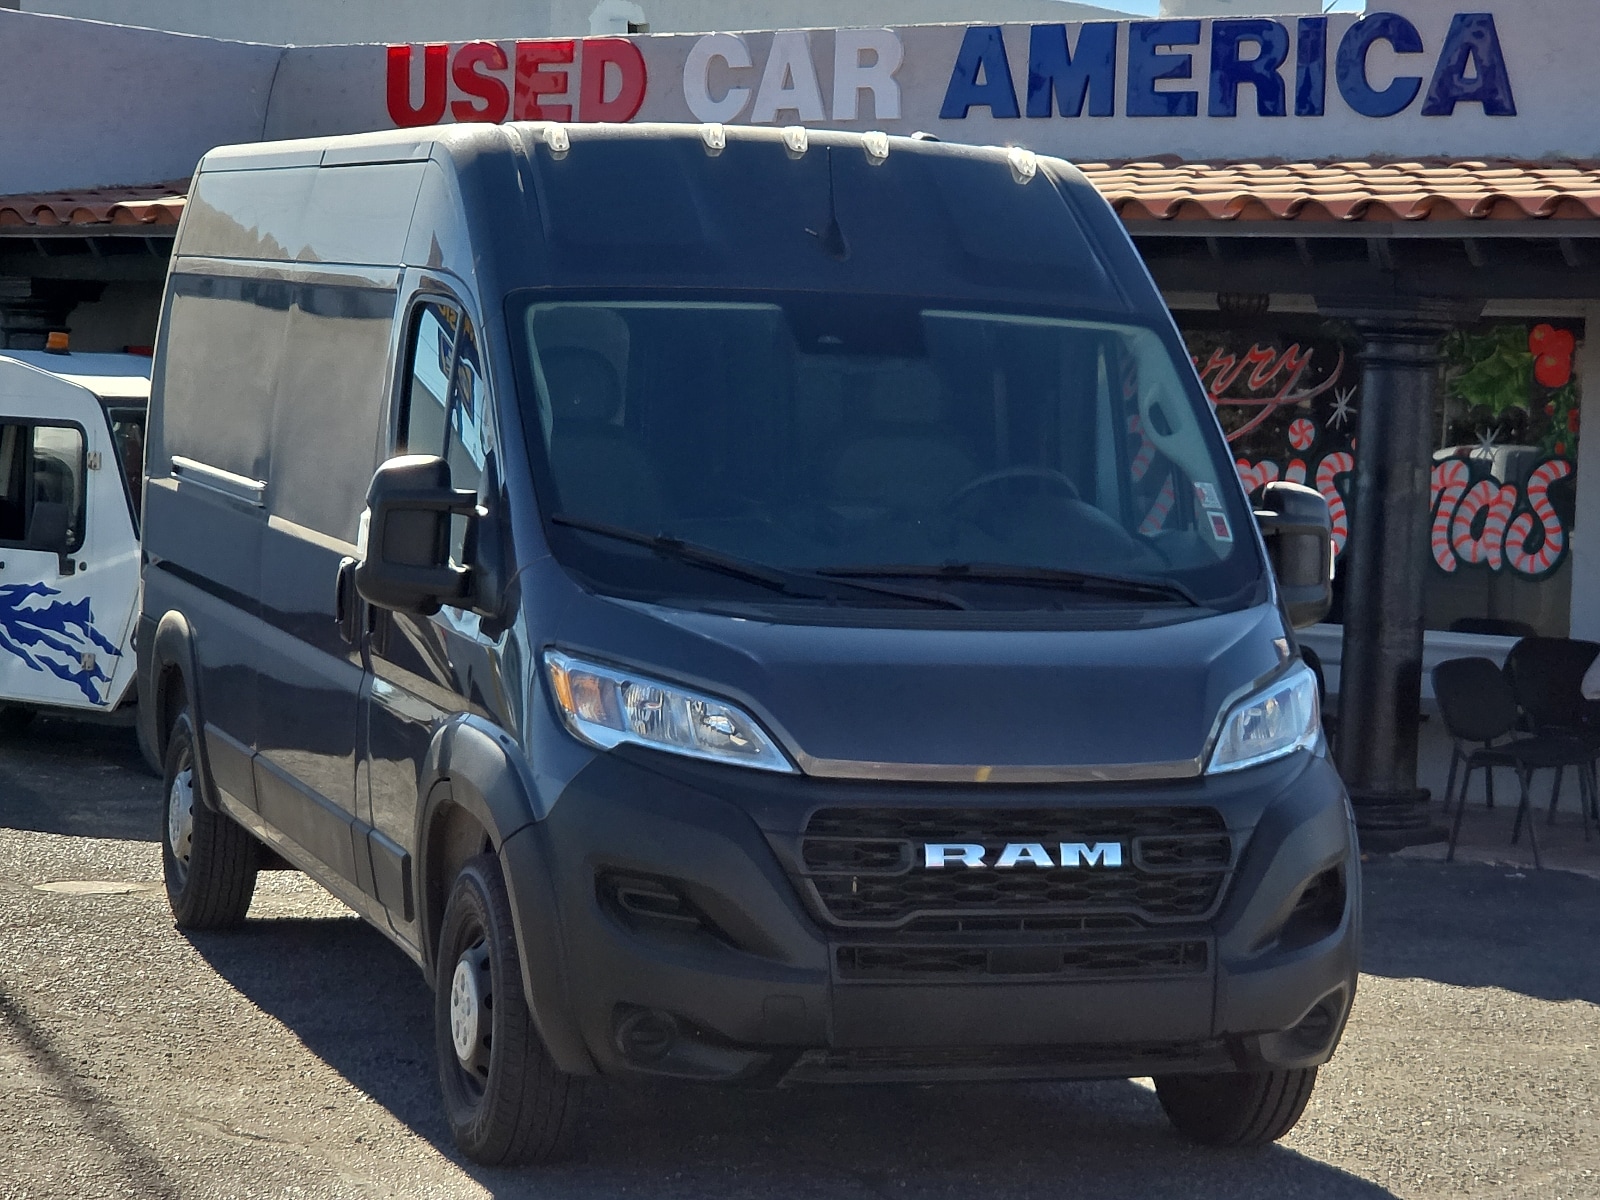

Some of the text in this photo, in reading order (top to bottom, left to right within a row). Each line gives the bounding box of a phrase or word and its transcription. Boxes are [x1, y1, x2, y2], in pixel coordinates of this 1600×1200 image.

[386, 12, 1518, 128] USED CAR AMERICA
[1193, 343, 1328, 442] rry
[924, 842, 1123, 868] RAM
